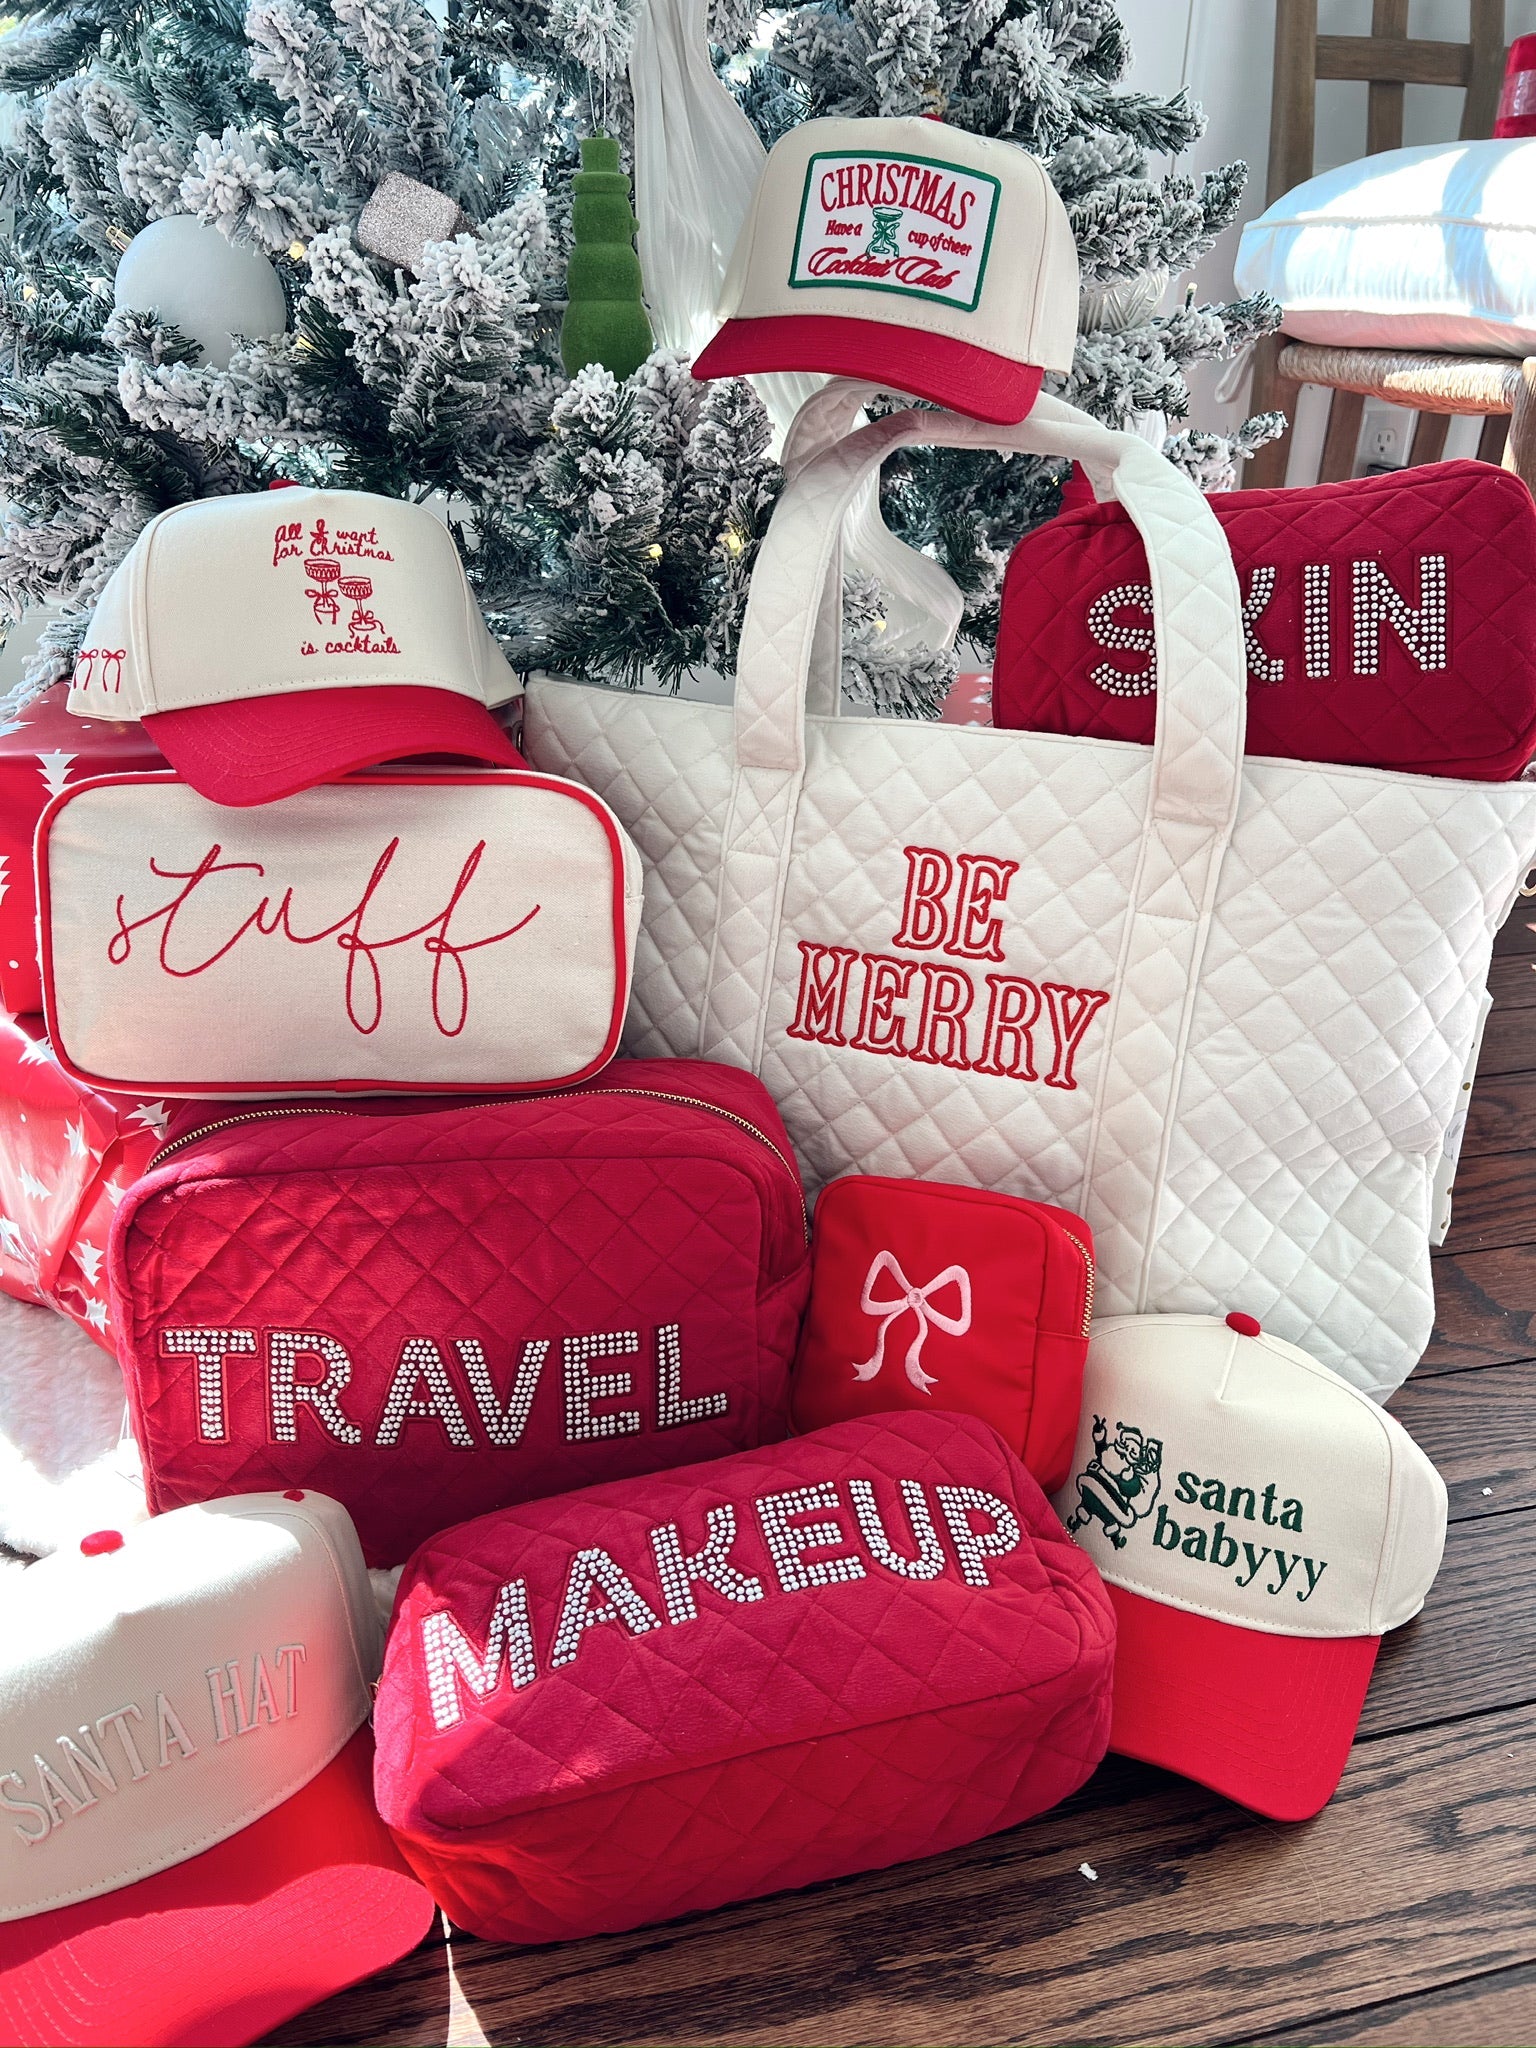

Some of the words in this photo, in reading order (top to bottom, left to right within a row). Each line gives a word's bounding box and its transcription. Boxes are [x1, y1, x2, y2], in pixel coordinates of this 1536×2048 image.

[821, 163, 976, 230] CHRISTMAS
[825, 220, 853, 236] Have
[808, 247, 893, 277] Cocktail
[895, 256, 960, 289] Club
[908, 230, 930, 249] cup
[929, 233, 945, 251] of
[942, 235, 972, 256] cheer
[272, 544, 303, 567] for
[310, 539, 394, 561] Christmas
[336, 528, 379, 545] want
[301, 641, 318, 656] is
[325, 634, 401, 654] cocktails
[1086, 555, 1448, 698] SKIN
[108, 836, 541, 1038] stuff
[892, 845, 1020, 963] BE
[785, 940, 1111, 1091] MERRY
[159, 1322, 730, 1447] TRAVEL
[1174, 1471, 1304, 1533] santa
[1152, 1503, 1328, 1602] babyyy
[421, 1478, 1022, 1732] MAKEUP
[0, 1690, 199, 1846] SANTA
[204, 1643, 308, 1743] HAT
